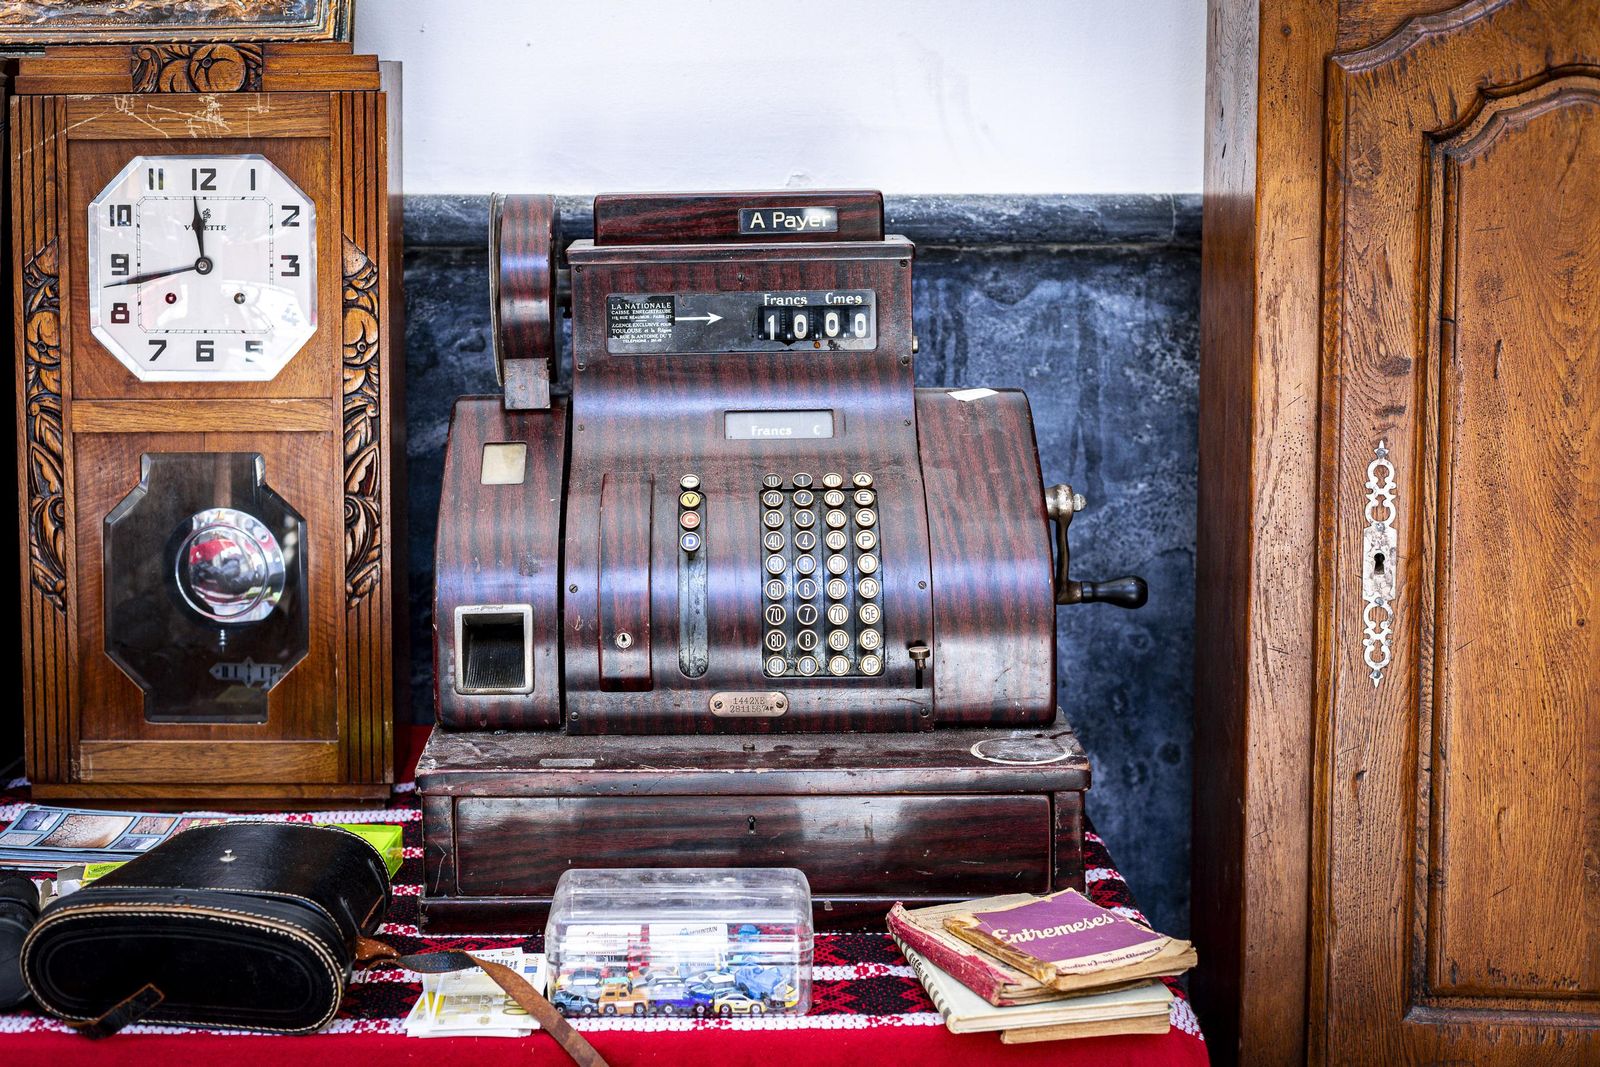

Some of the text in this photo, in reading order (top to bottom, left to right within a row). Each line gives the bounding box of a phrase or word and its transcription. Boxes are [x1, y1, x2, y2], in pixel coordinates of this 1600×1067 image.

[148, 168, 164, 190] 11
[191, 168, 216, 190] 12
[250, 168, 256, 190] 1
[109, 204, 132, 227] 10
[281, 205, 300, 228] 2
[750, 212, 832, 230] A Payer
[111, 253, 130, 276] 9
[281, 255, 300, 276] 3
[764, 292, 863, 306] Francs Cmes
[111, 302, 130, 324] 8
[148, 340, 167, 362] 7
[196, 340, 214, 362] 6
[245, 340, 264, 362] 5
[752, 425, 820, 436] Francs C
[767, 476, 777, 486] 10
[800, 476, 804, 485] 1
[829, 476, 838, 484] 10
[769, 494, 778, 504] 20
[801, 494, 806, 503] 2
[830, 493, 840, 504] 20
[685, 516, 696, 524] C
[769, 514, 779, 524] 30
[802, 513, 808, 524] 3
[831, 513, 841, 524] 30
[861, 514, 870, 522] S
[686, 537, 696, 546] D
[768, 535, 780, 547] 40
[802, 535, 808, 546] 4
[831, 535, 841, 546] 40
[862, 536, 870, 545] P
[770, 557, 781, 570] 50
[803, 557, 809, 570] 5
[833, 557, 843, 570] 50
[864, 557, 870, 569] 5
[771, 583, 781, 596] 60
[804, 583, 810, 596] 6
[832, 583, 843, 595] 60
[864, 582, 875, 594] 5A
[770, 608, 781, 621] 70
[805, 608, 811, 621] 7
[833, 608, 844, 621] 70
[865, 607, 876, 620] 5E
[771, 634, 781, 647] 80
[805, 634, 811, 646] 8
[834, 634, 844, 646] 80
[866, 633, 876, 645] 5S
[772, 660, 781, 672] 90
[806, 660, 811, 672] 9
[834, 660, 845, 671] 90
[866, 659, 876, 671] 5P
[992, 913, 1114, 944] Entremeses
